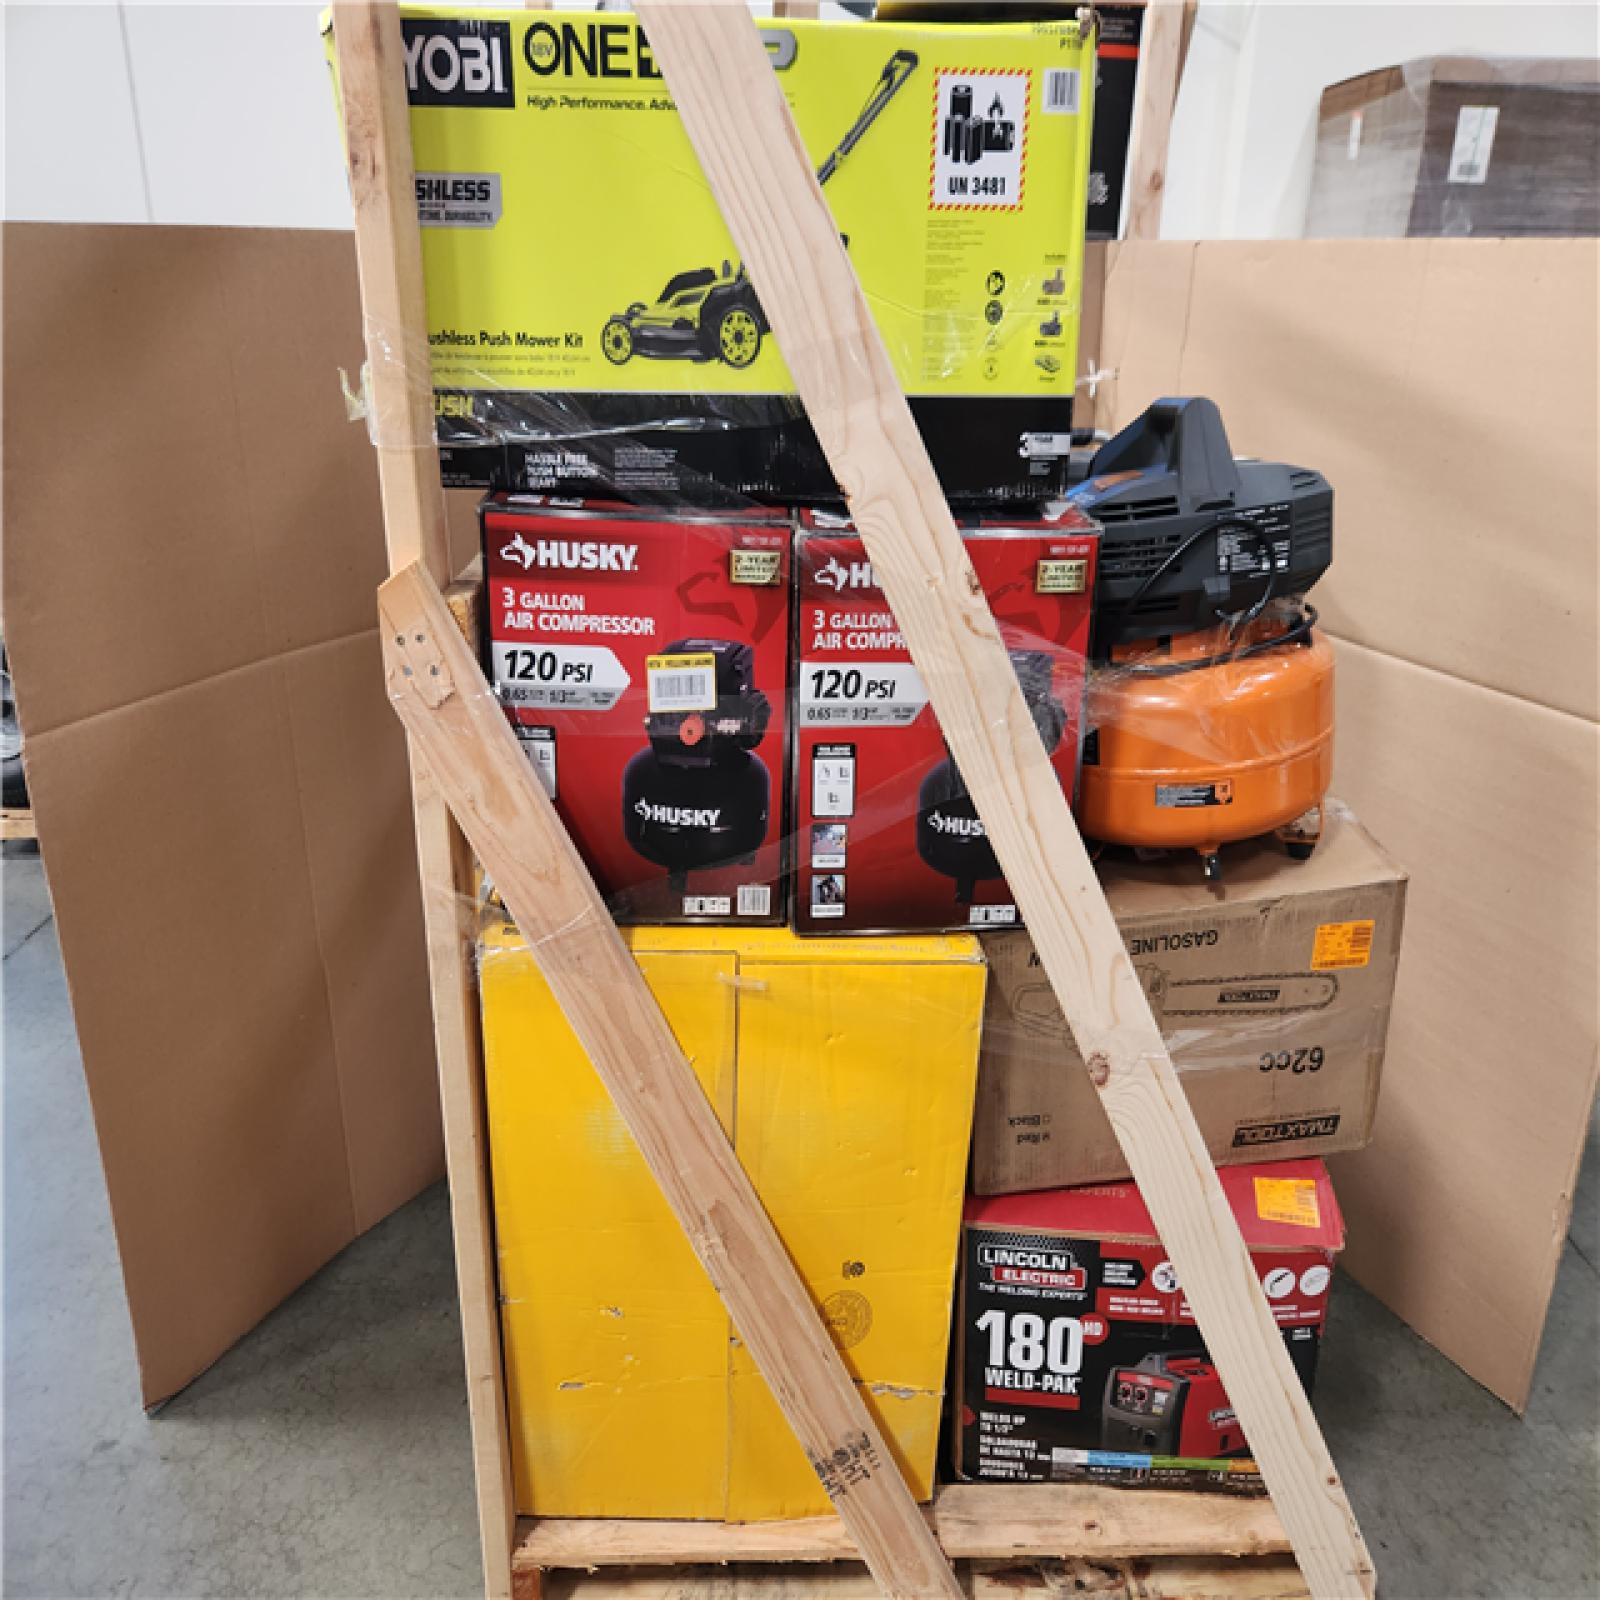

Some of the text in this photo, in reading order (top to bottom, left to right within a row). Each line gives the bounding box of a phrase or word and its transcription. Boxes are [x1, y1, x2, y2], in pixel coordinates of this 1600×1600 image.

[402, 34, 507, 93] YOBI
[527, 95, 555, 110] High
[414, 179, 491, 201] SHLESS
[948, 176, 1006, 196] UN 3481
[429, 330, 583, 348] ushless Push Mower Kit
[434, 394, 473, 416] USH
[503, 588, 585, 611] 3 GALLON
[504, 611, 655, 635] AIR COMPRESSOR
[813, 610, 894, 631] 3 GALLON
[813, 632, 909, 650] AIR COMPR
[505, 650, 593, 684] 120 PSI
[811, 669, 895, 699] 120 PSI
[652, 805, 721, 827] HUSKY
[944, 817, 986, 836] HUS
[1130, 930, 1218, 956] GASOLINE
[1259, 1046, 1323, 1075] 62cc
[1008, 1114, 1041, 1128] Black
[1017, 1133, 1041, 1145] Red
[984, 1248, 1067, 1271] LINCOLN
[1002, 1269, 1076, 1287] ELECTRIC
[975, 1309, 1084, 1375] 180
[985, 1367, 1078, 1395] WELD-PAK
